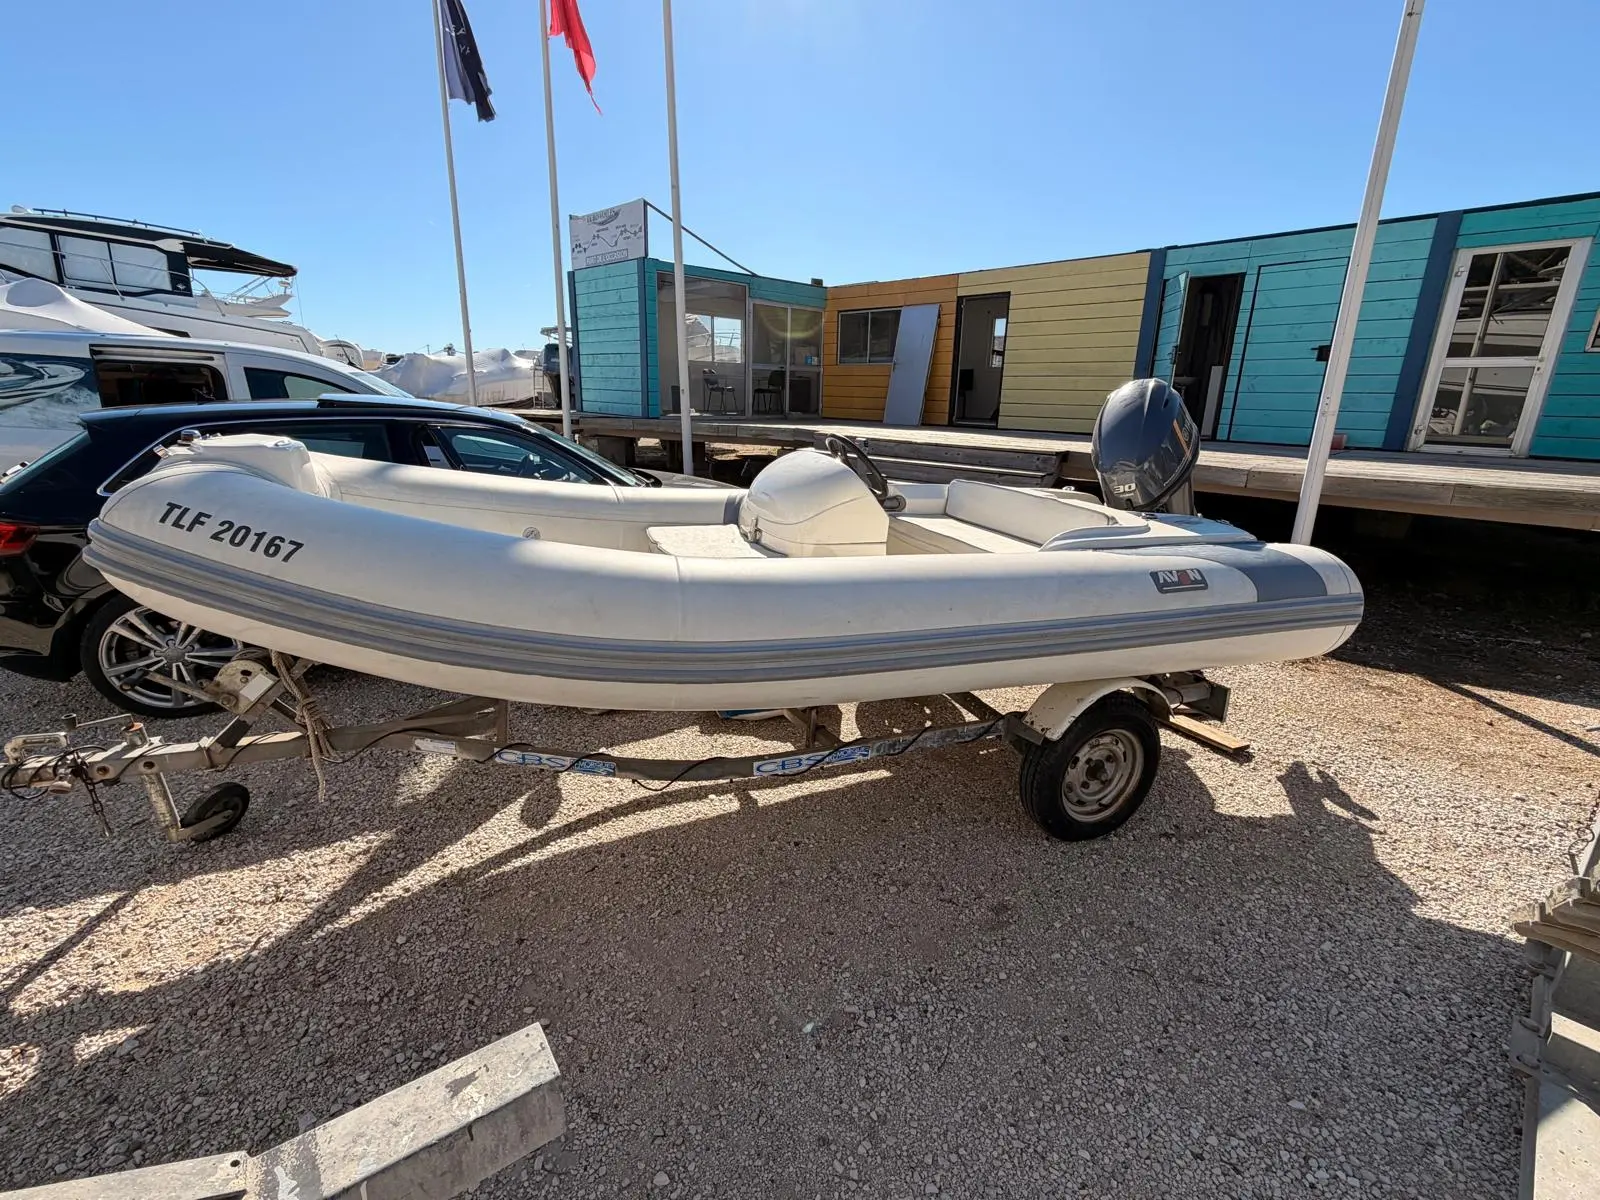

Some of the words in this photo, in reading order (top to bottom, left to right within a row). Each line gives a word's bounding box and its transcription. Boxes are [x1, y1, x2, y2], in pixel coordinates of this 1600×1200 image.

[1113, 482, 1136, 495] 30
[159, 502, 212, 532] TLF
[210, 520, 304, 563] 20167
[497, 751, 567, 768] CBS
